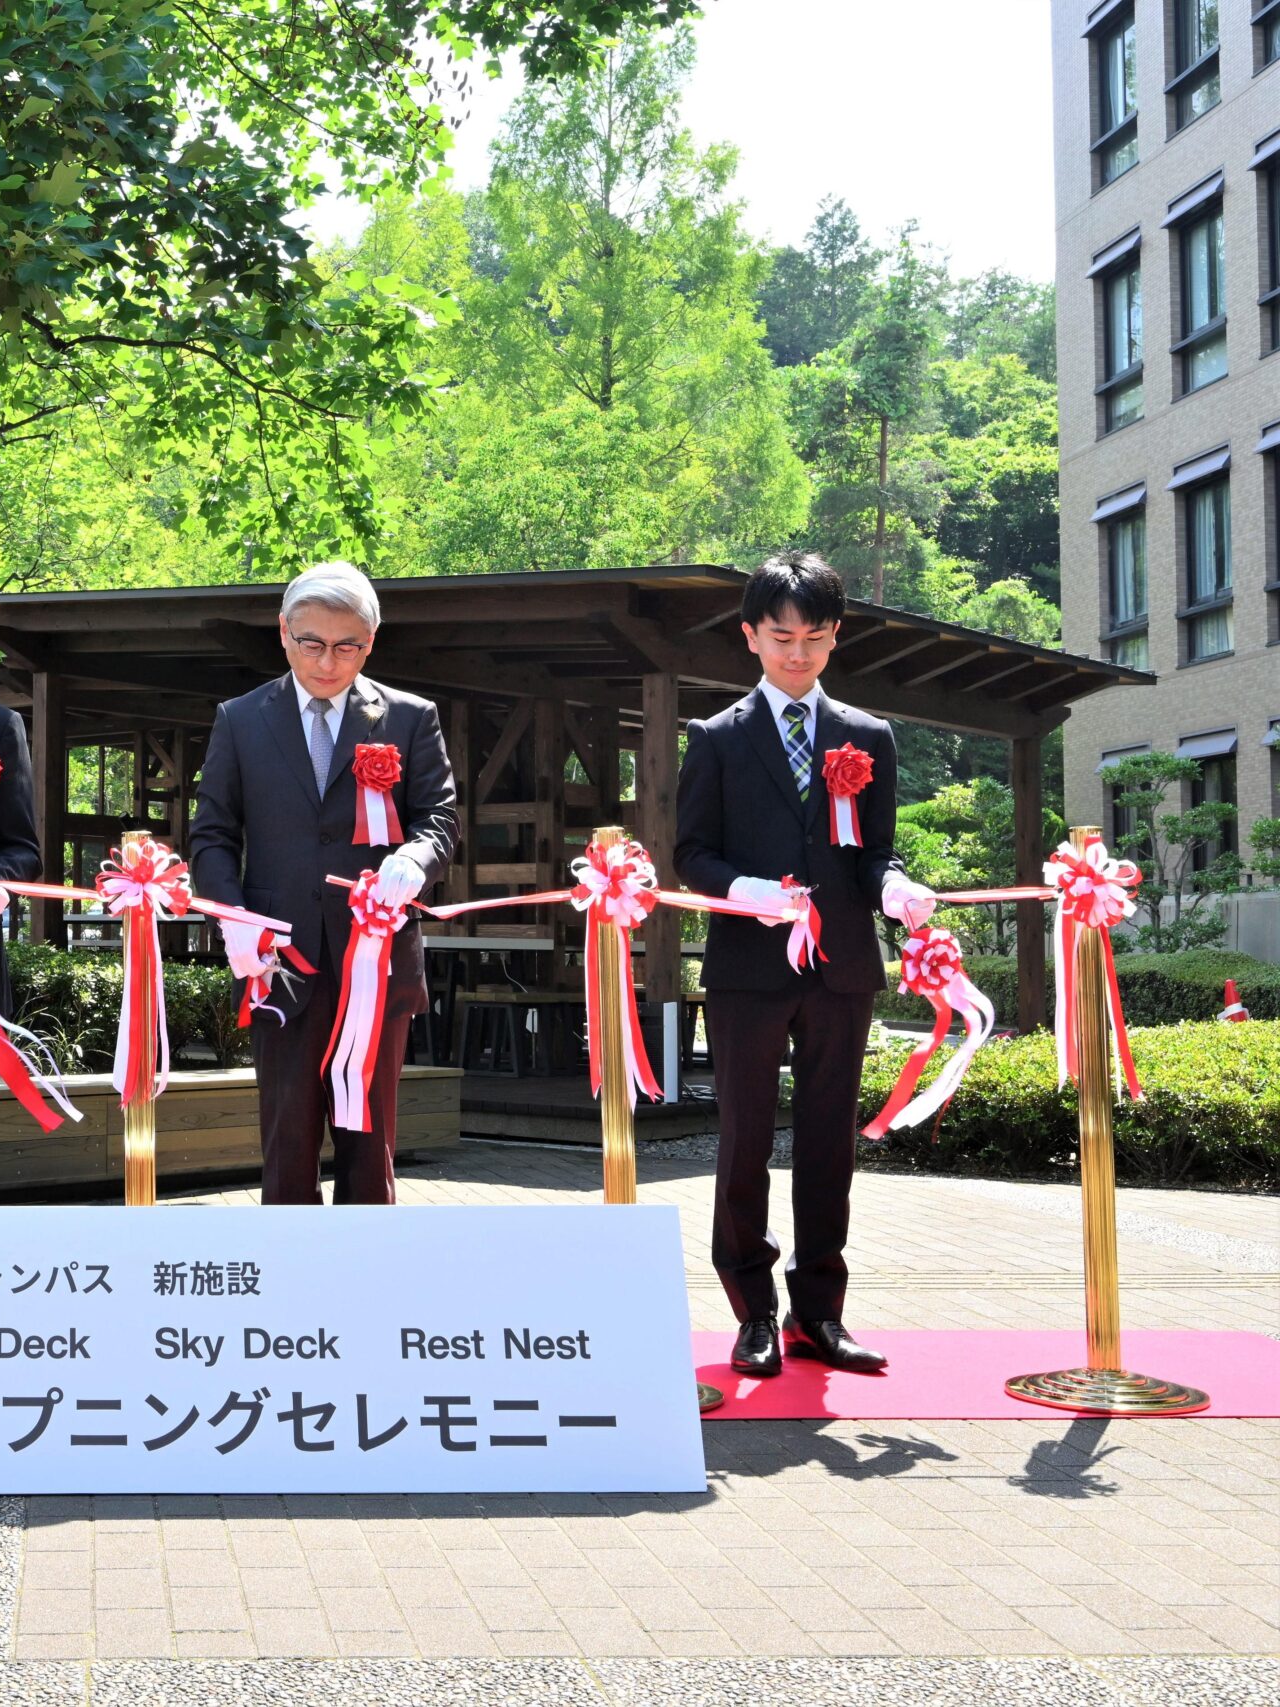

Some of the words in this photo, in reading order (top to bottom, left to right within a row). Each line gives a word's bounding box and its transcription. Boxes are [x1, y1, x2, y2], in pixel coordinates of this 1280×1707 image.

[153, 1260, 261, 1297] 新施設
[154, 1326, 225, 1368] Sky
[243, 1327, 341, 1360] Deck
[400, 1327, 486, 1360] Rest
[503, 1327, 592, 1360] Nest
